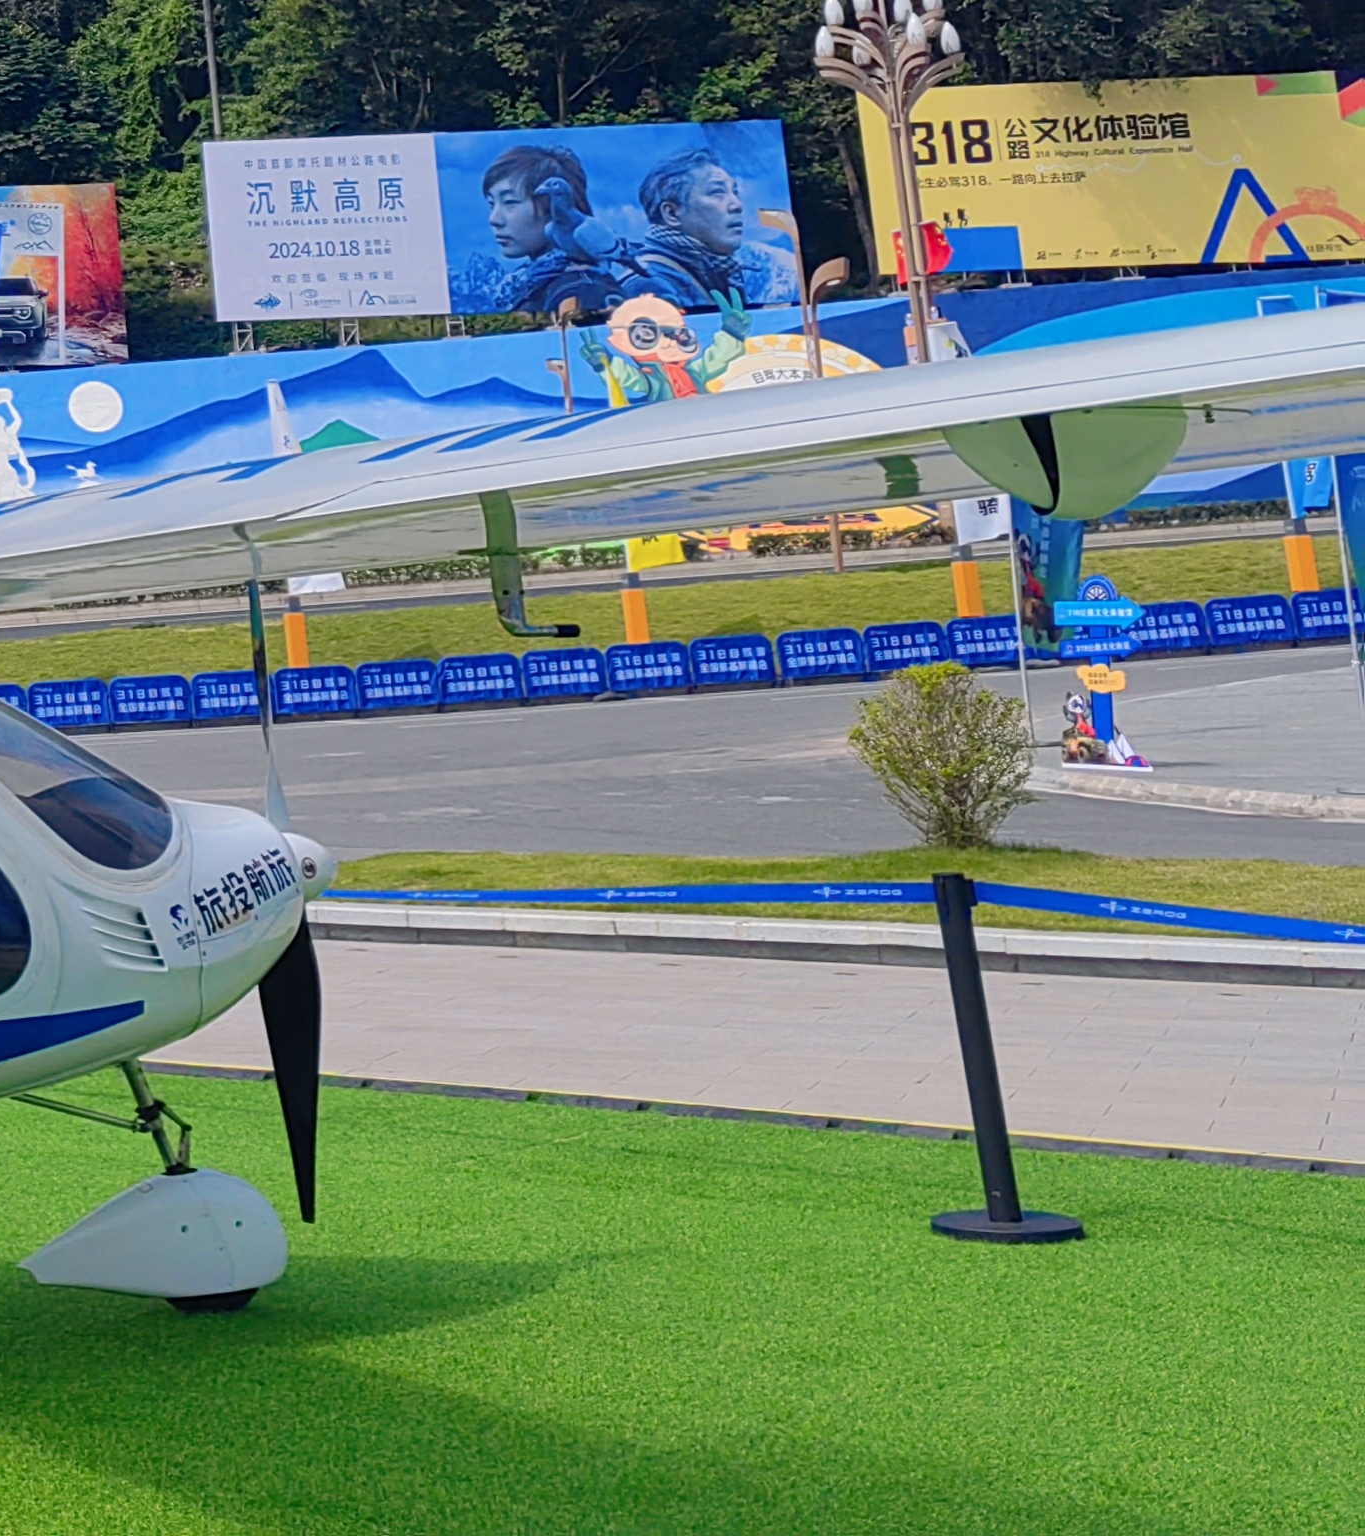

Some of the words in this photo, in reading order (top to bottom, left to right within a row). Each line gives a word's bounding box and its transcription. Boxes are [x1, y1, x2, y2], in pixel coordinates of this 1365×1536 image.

[1031, 112, 1191, 145] 文化体验馆
[1035, 150, 1050, 158] 318
[1055, 149, 1089, 159] Highway
[1094, 147, 1124, 156] Cultural
[1178, 144, 1194, 153] Hall
[246, 177, 405, 215] 沉默高原
[273, 218, 329, 227] HIGHLAND
[333, 216, 408, 225] REFLECTIONS
[268, 239, 361, 259] 2024.10.18
[977, 497, 999, 516] 骑
[844, 888, 903, 896] ZEROG
[1131, 906, 1187, 920] ZEROG
